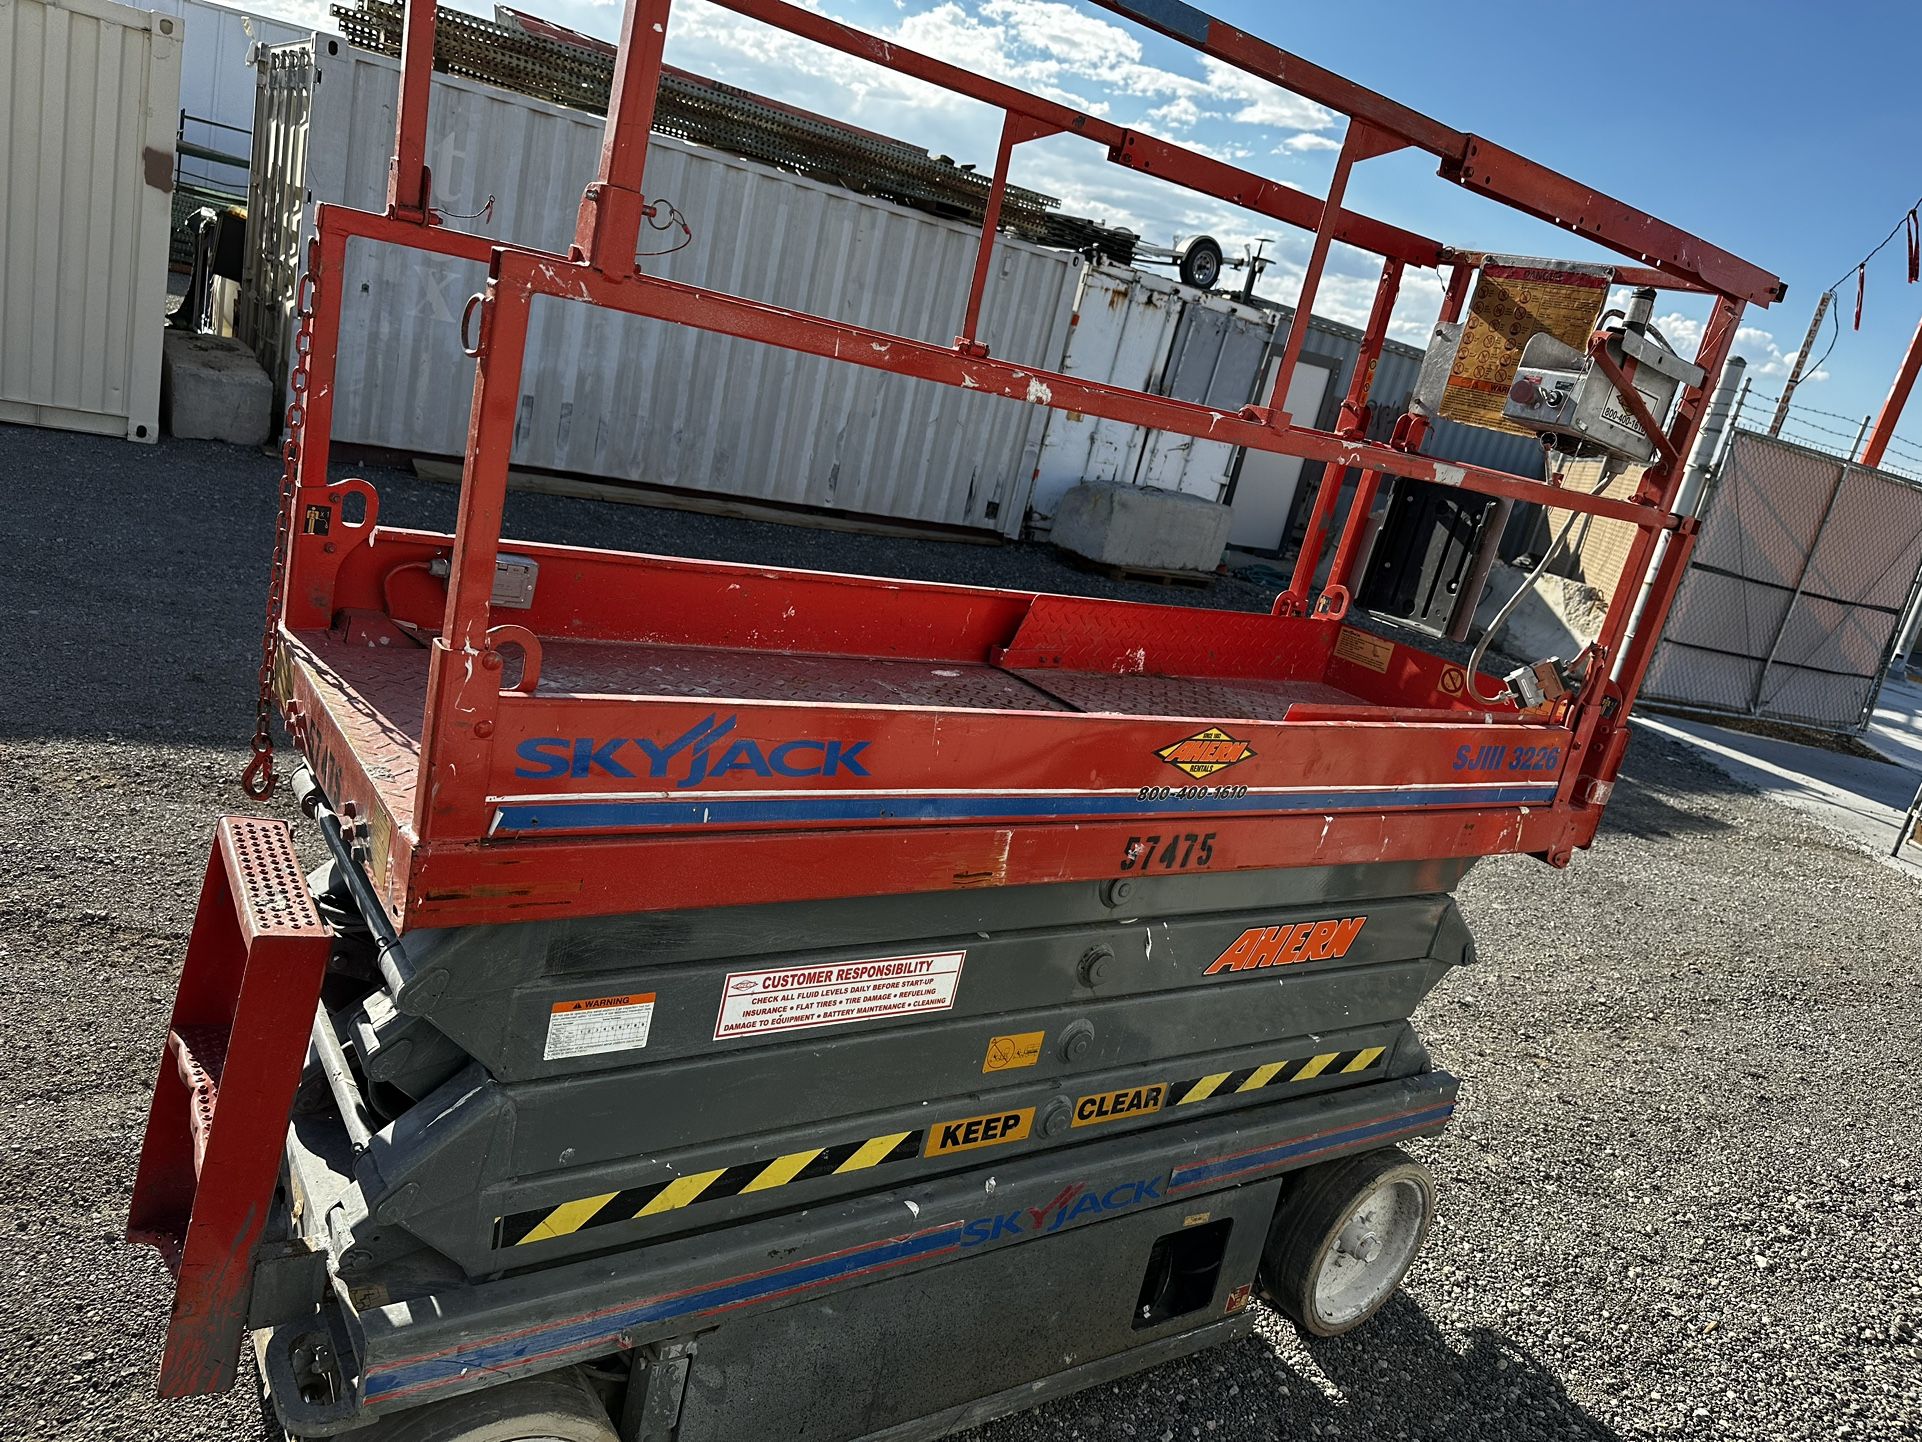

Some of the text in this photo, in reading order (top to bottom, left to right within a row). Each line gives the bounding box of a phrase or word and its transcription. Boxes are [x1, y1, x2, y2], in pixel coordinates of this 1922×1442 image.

[1770, 297, 1829, 435] EXTENDED POWER
[514, 712, 873, 789] SKYJACK
[1163, 740, 1250, 763] AHERN
[1508, 745, 1559, 770] 3226
[1190, 765, 1213, 773] RENTALS
[1136, 784, 1248, 801] 800-400-1610
[1120, 832, 1216, 871] 57475
[1203, 917, 1367, 975] AHERN
[763, 971, 837, 989] CUSTOMER
[836, 960, 934, 981] RESPONSIBILITY
[584, 997, 629, 1008] WARNING
[742, 988, 936, 1017] INSURANCE FLAT TIRES TIRE DAMAGE REFUELING
[751, 978, 934, 1005] CHECK ALL FLUID LEVELS DAILY BEFORE START-UP
[723, 997, 946, 1031] DAMAGE TO EQUIPMENT BATTERY MAINTENANCE CLEANING
[939, 1086, 1162, 1149] KEEP CLEAR
[960, 1175, 1164, 1247] SKYJACK
